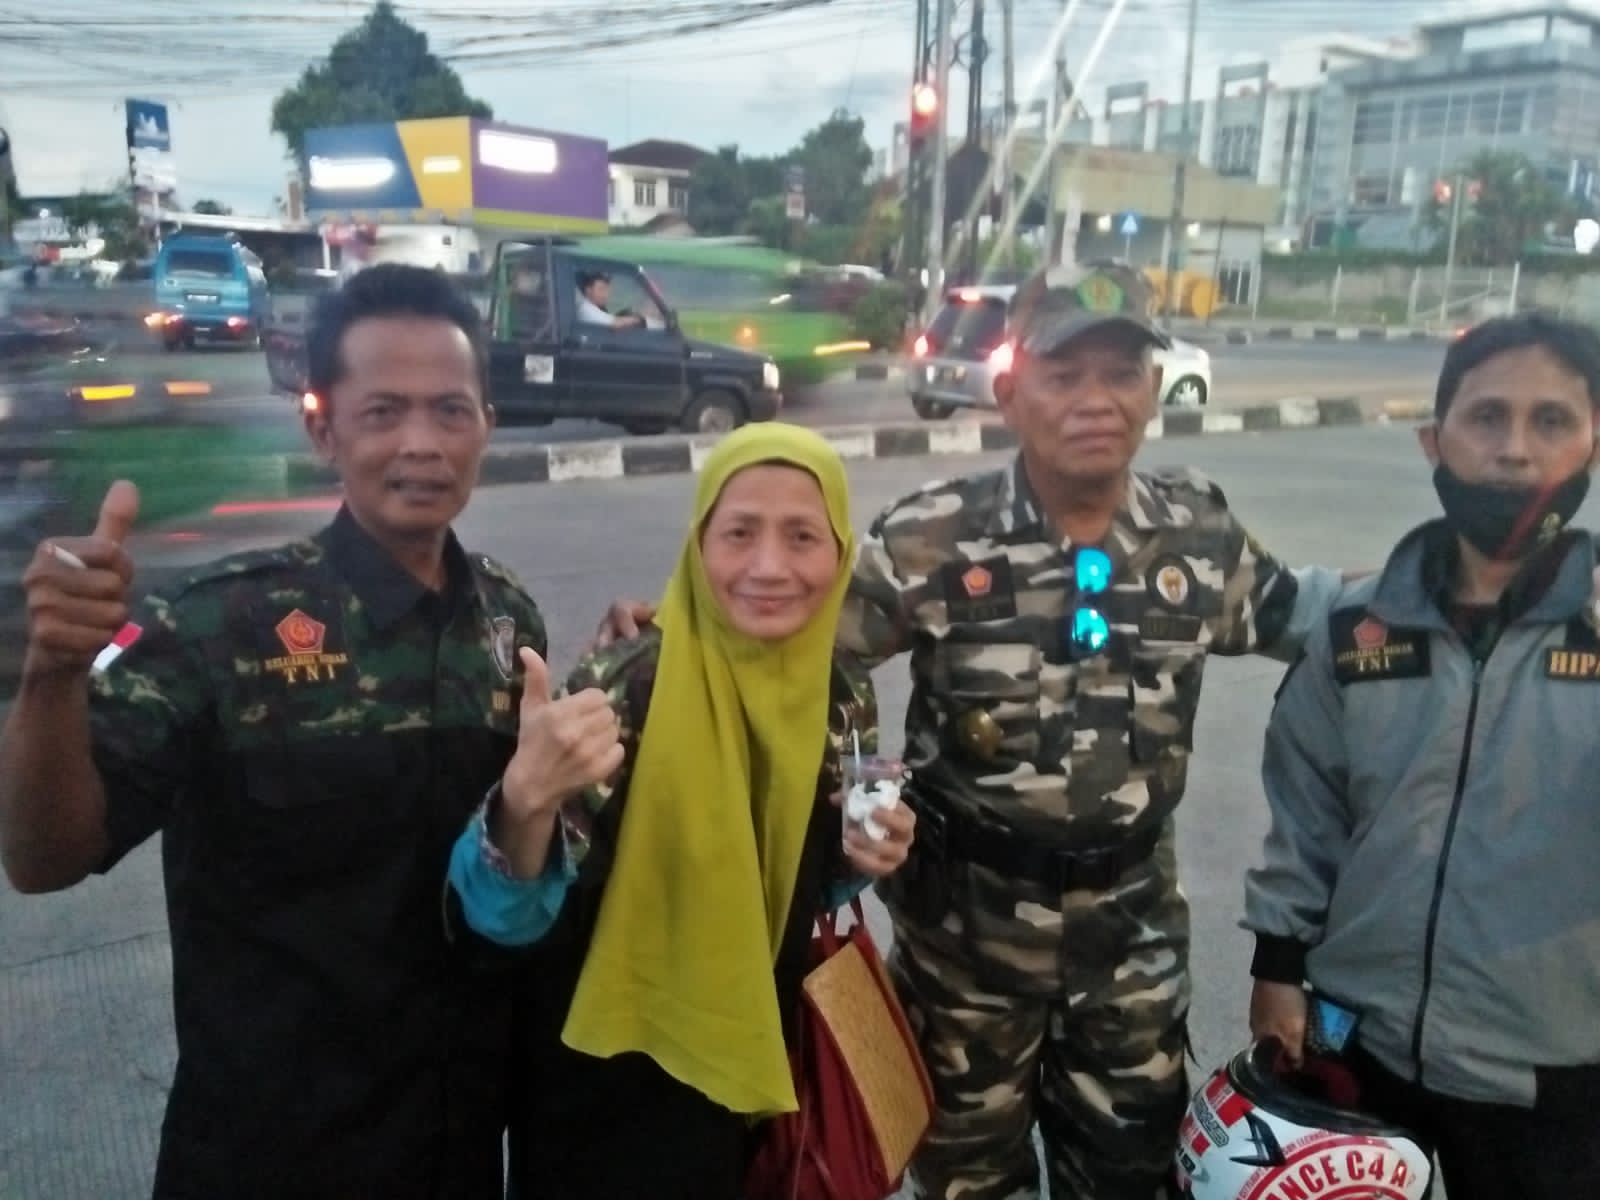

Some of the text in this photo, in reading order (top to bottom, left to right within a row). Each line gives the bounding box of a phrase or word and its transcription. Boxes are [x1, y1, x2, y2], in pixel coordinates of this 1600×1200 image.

[1354, 656, 1390, 672] TNI
[284, 665, 337, 682] TNI
[1346, 1149, 1384, 1181] C4
